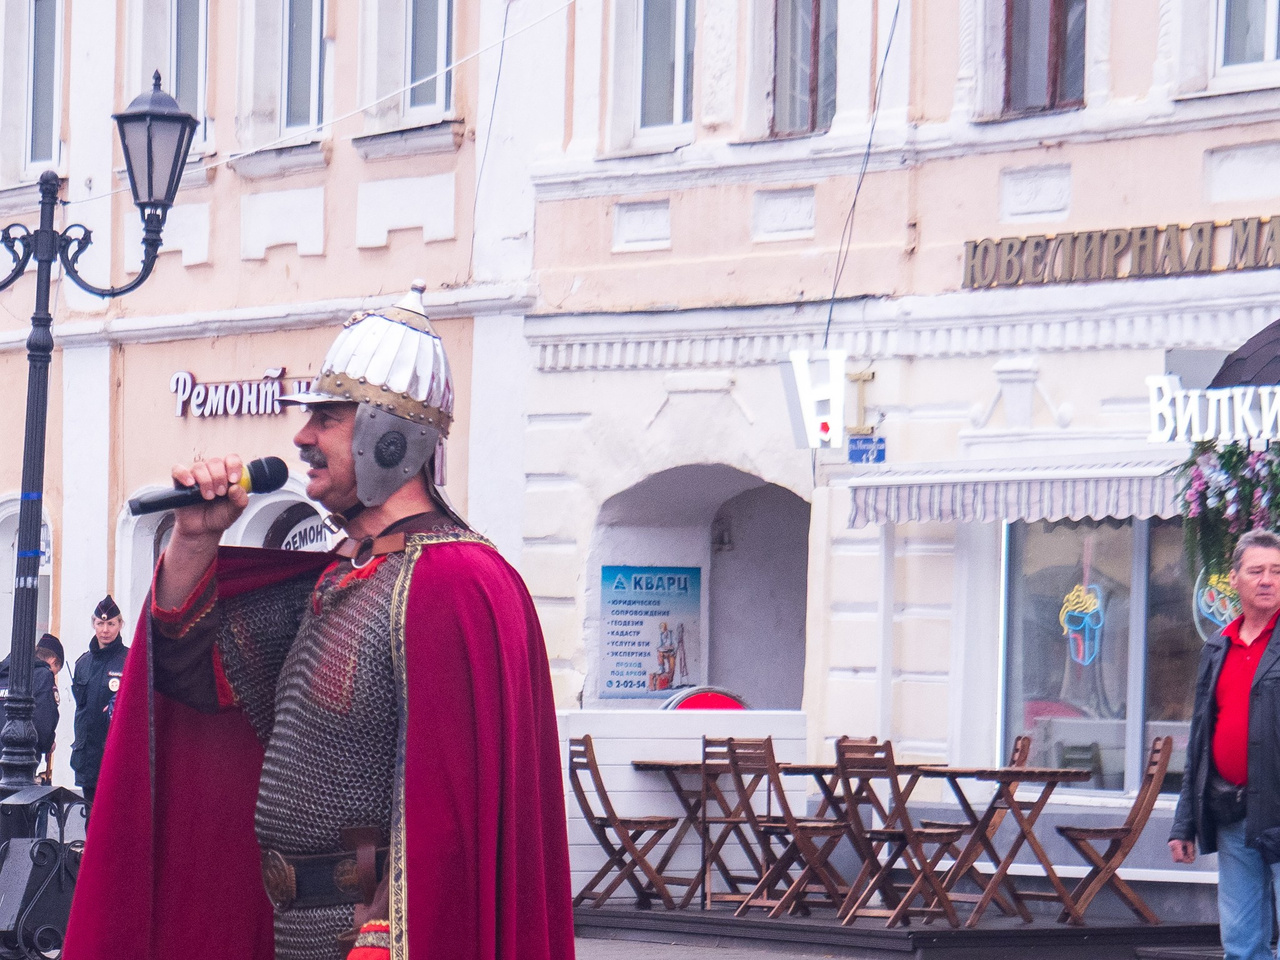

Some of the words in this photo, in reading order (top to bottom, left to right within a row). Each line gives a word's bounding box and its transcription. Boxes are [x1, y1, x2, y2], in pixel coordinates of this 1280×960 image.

[961, 221, 1214, 289] ЮВЕЛИРНАЯ
[170, 367, 284, 417] Ремонт
[633, 576, 689, 592] КВАРЦ
[610, 609, 670, 617] СОПРОВОЖДЕНИЕ
[615, 680, 646, 689] 2-02-54
